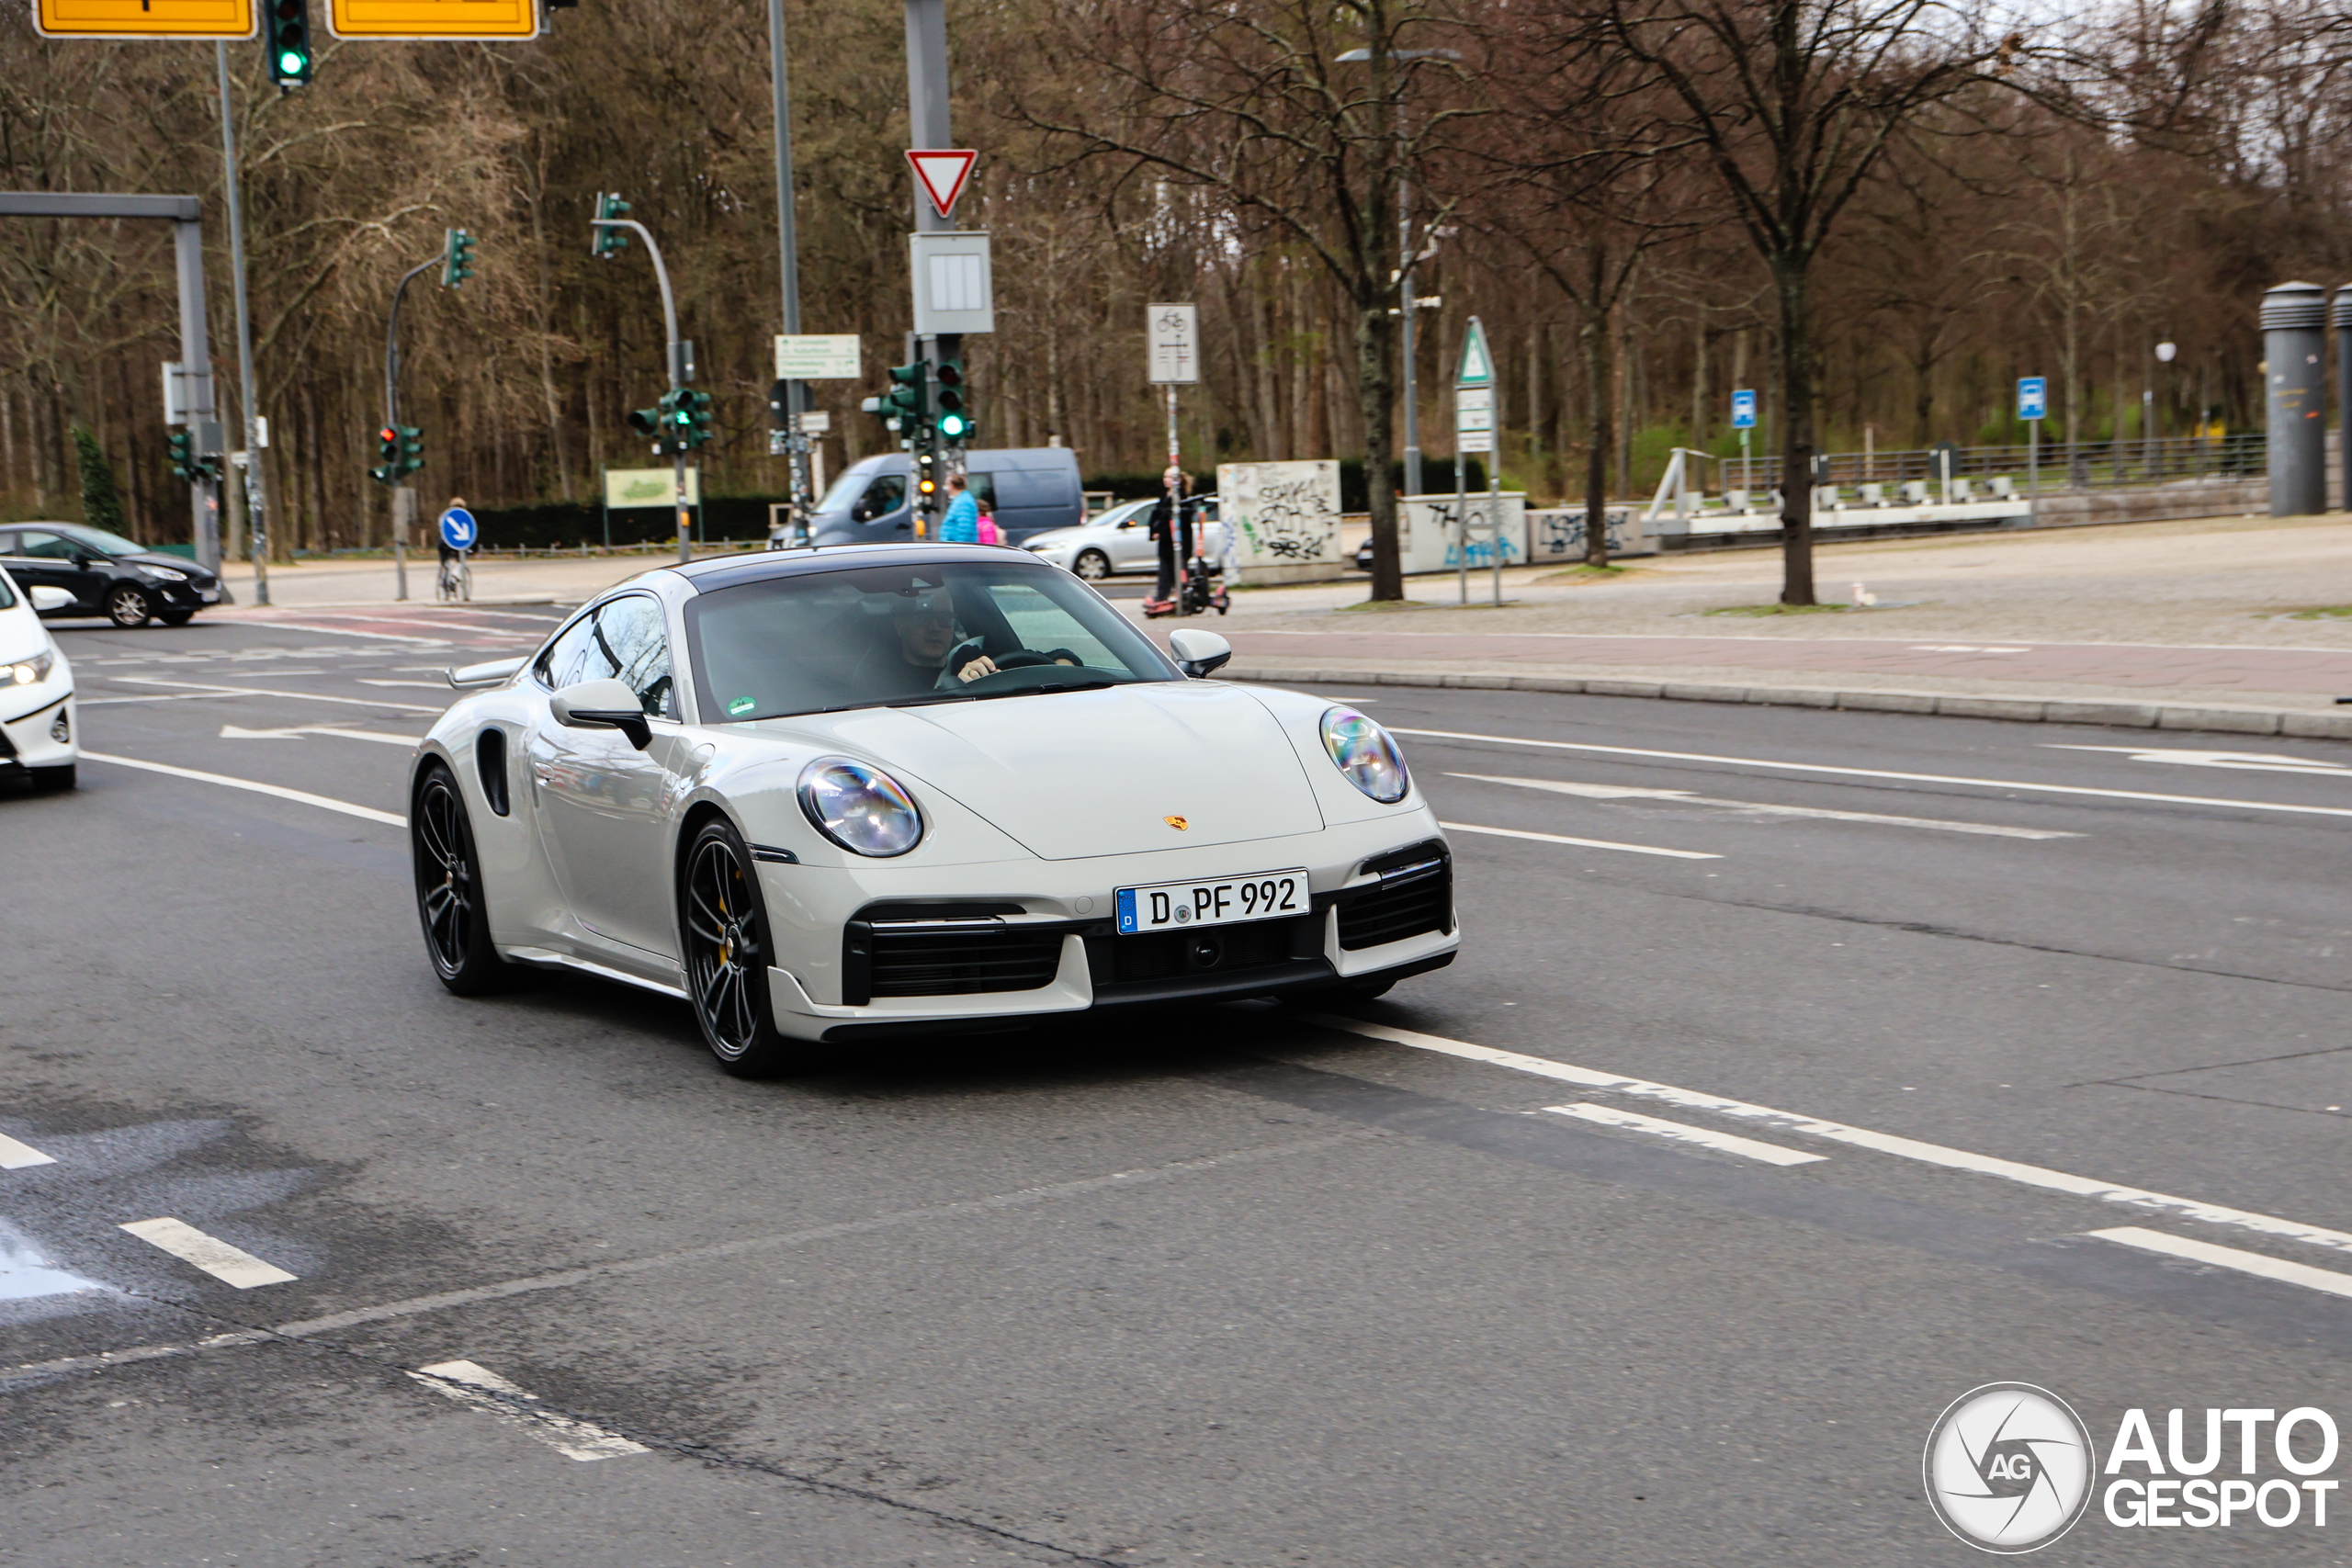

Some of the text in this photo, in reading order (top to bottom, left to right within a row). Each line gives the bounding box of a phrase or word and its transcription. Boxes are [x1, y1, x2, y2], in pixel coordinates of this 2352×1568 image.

[1150, 878, 1295, 924] D PF 992
[1124, 916, 1132, 926] D
